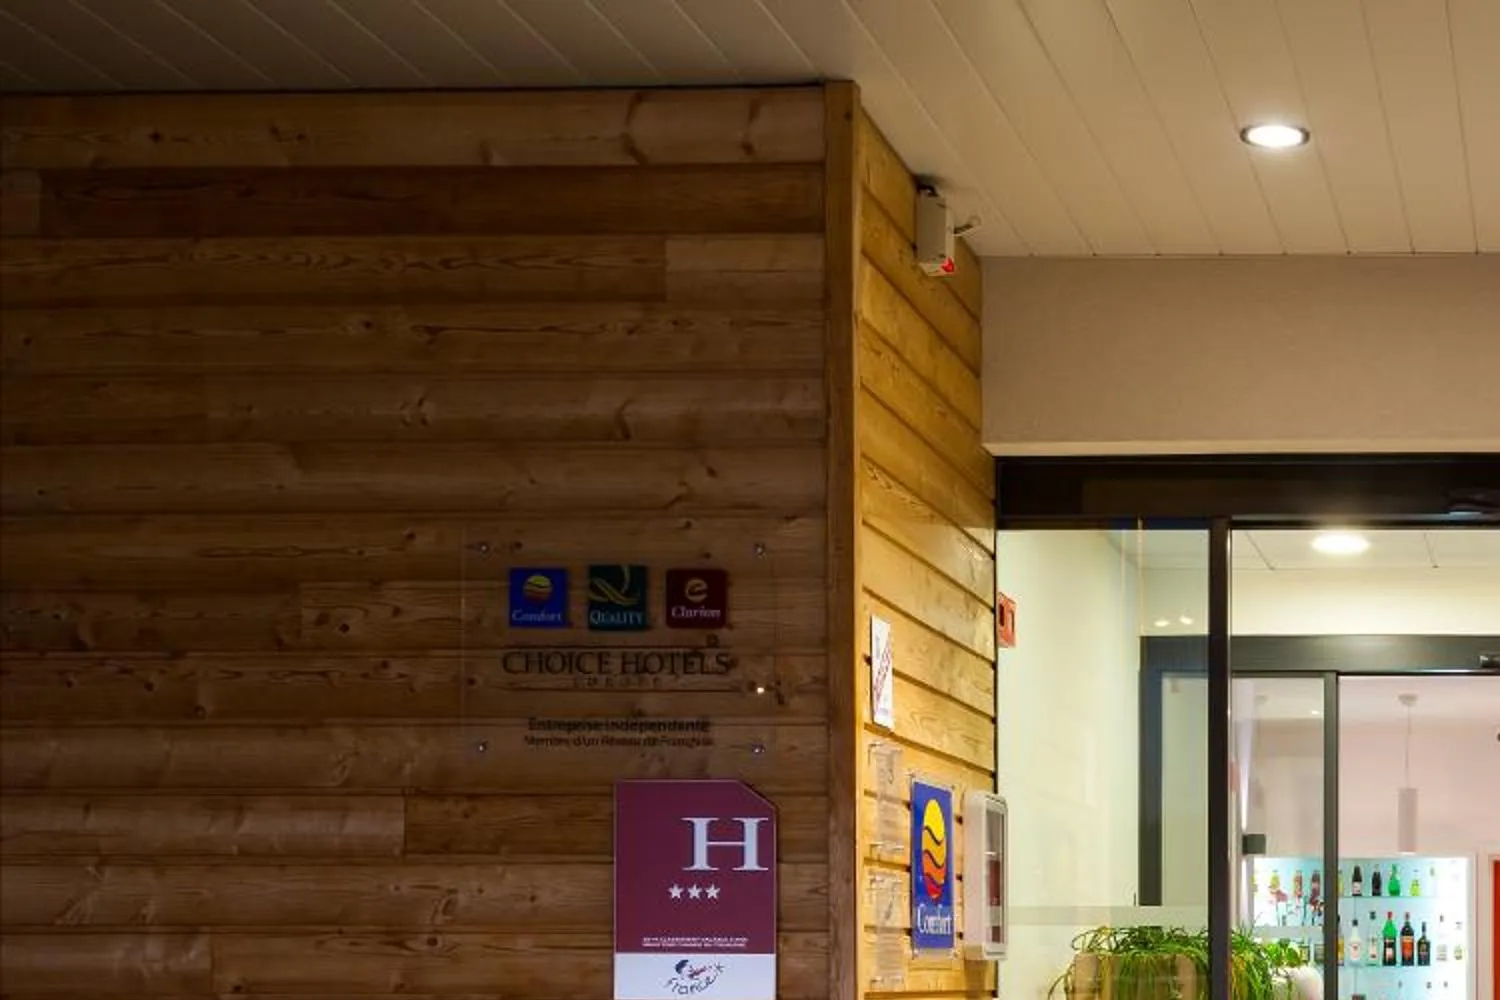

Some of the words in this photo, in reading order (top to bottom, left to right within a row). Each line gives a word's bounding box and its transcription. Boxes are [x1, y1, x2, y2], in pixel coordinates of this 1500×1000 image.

[671, 605, 721, 619] Clarion
[502, 650, 611, 675] CHOICE
[621, 650, 730, 675] HOTELS
[681, 817, 769, 872] H
[917, 903, 952, 935] Comfort
